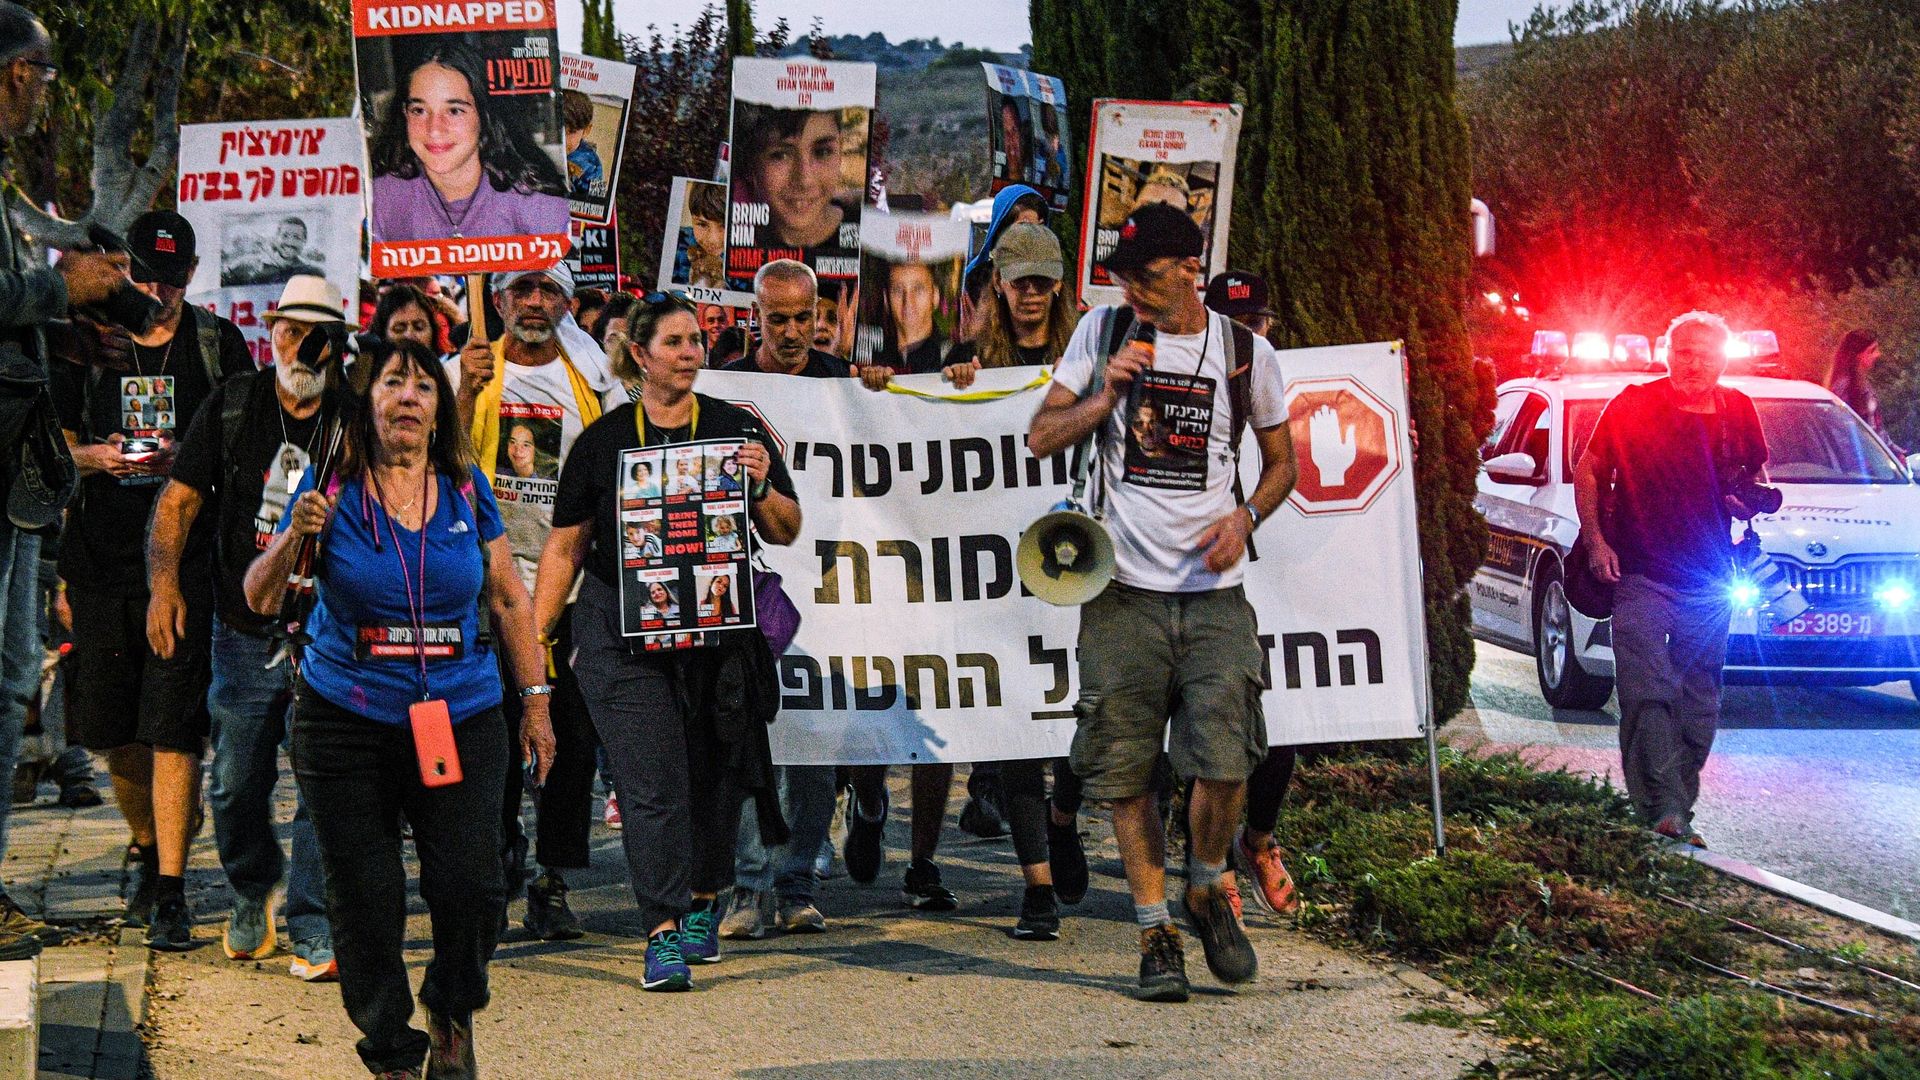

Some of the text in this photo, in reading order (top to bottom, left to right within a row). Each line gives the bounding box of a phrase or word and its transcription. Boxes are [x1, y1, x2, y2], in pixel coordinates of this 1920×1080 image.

[367, 1, 545, 29] KIDNAPPED
[486, 58, 552, 90] עכשיו!
[732, 201, 770, 226] BRING
[584, 229, 608, 248] K!
[731, 224, 755, 247] HIM
[1097, 229, 1120, 247] BRI
[381, 236, 563, 268] גלי חטופה בעזה
[729, 248, 764, 270] HOME
[1164, 403, 1210, 421] אבינתן
[1175, 420, 1209, 435] עדיין
[793, 433, 1068, 498] הומניטרי
[494, 477, 558, 493] מחזירים אות
[493, 488, 557, 505] הביתה עכש
[667, 511, 699, 521] BRING
[669, 520, 698, 529] THEM
[667, 529, 698, 539] HOME
[664, 541, 704, 556] NOW!
[815, 532, 1034, 604] מורת
[1027, 634, 1080, 704] ל
[780, 653, 1002, 711] החטופ
